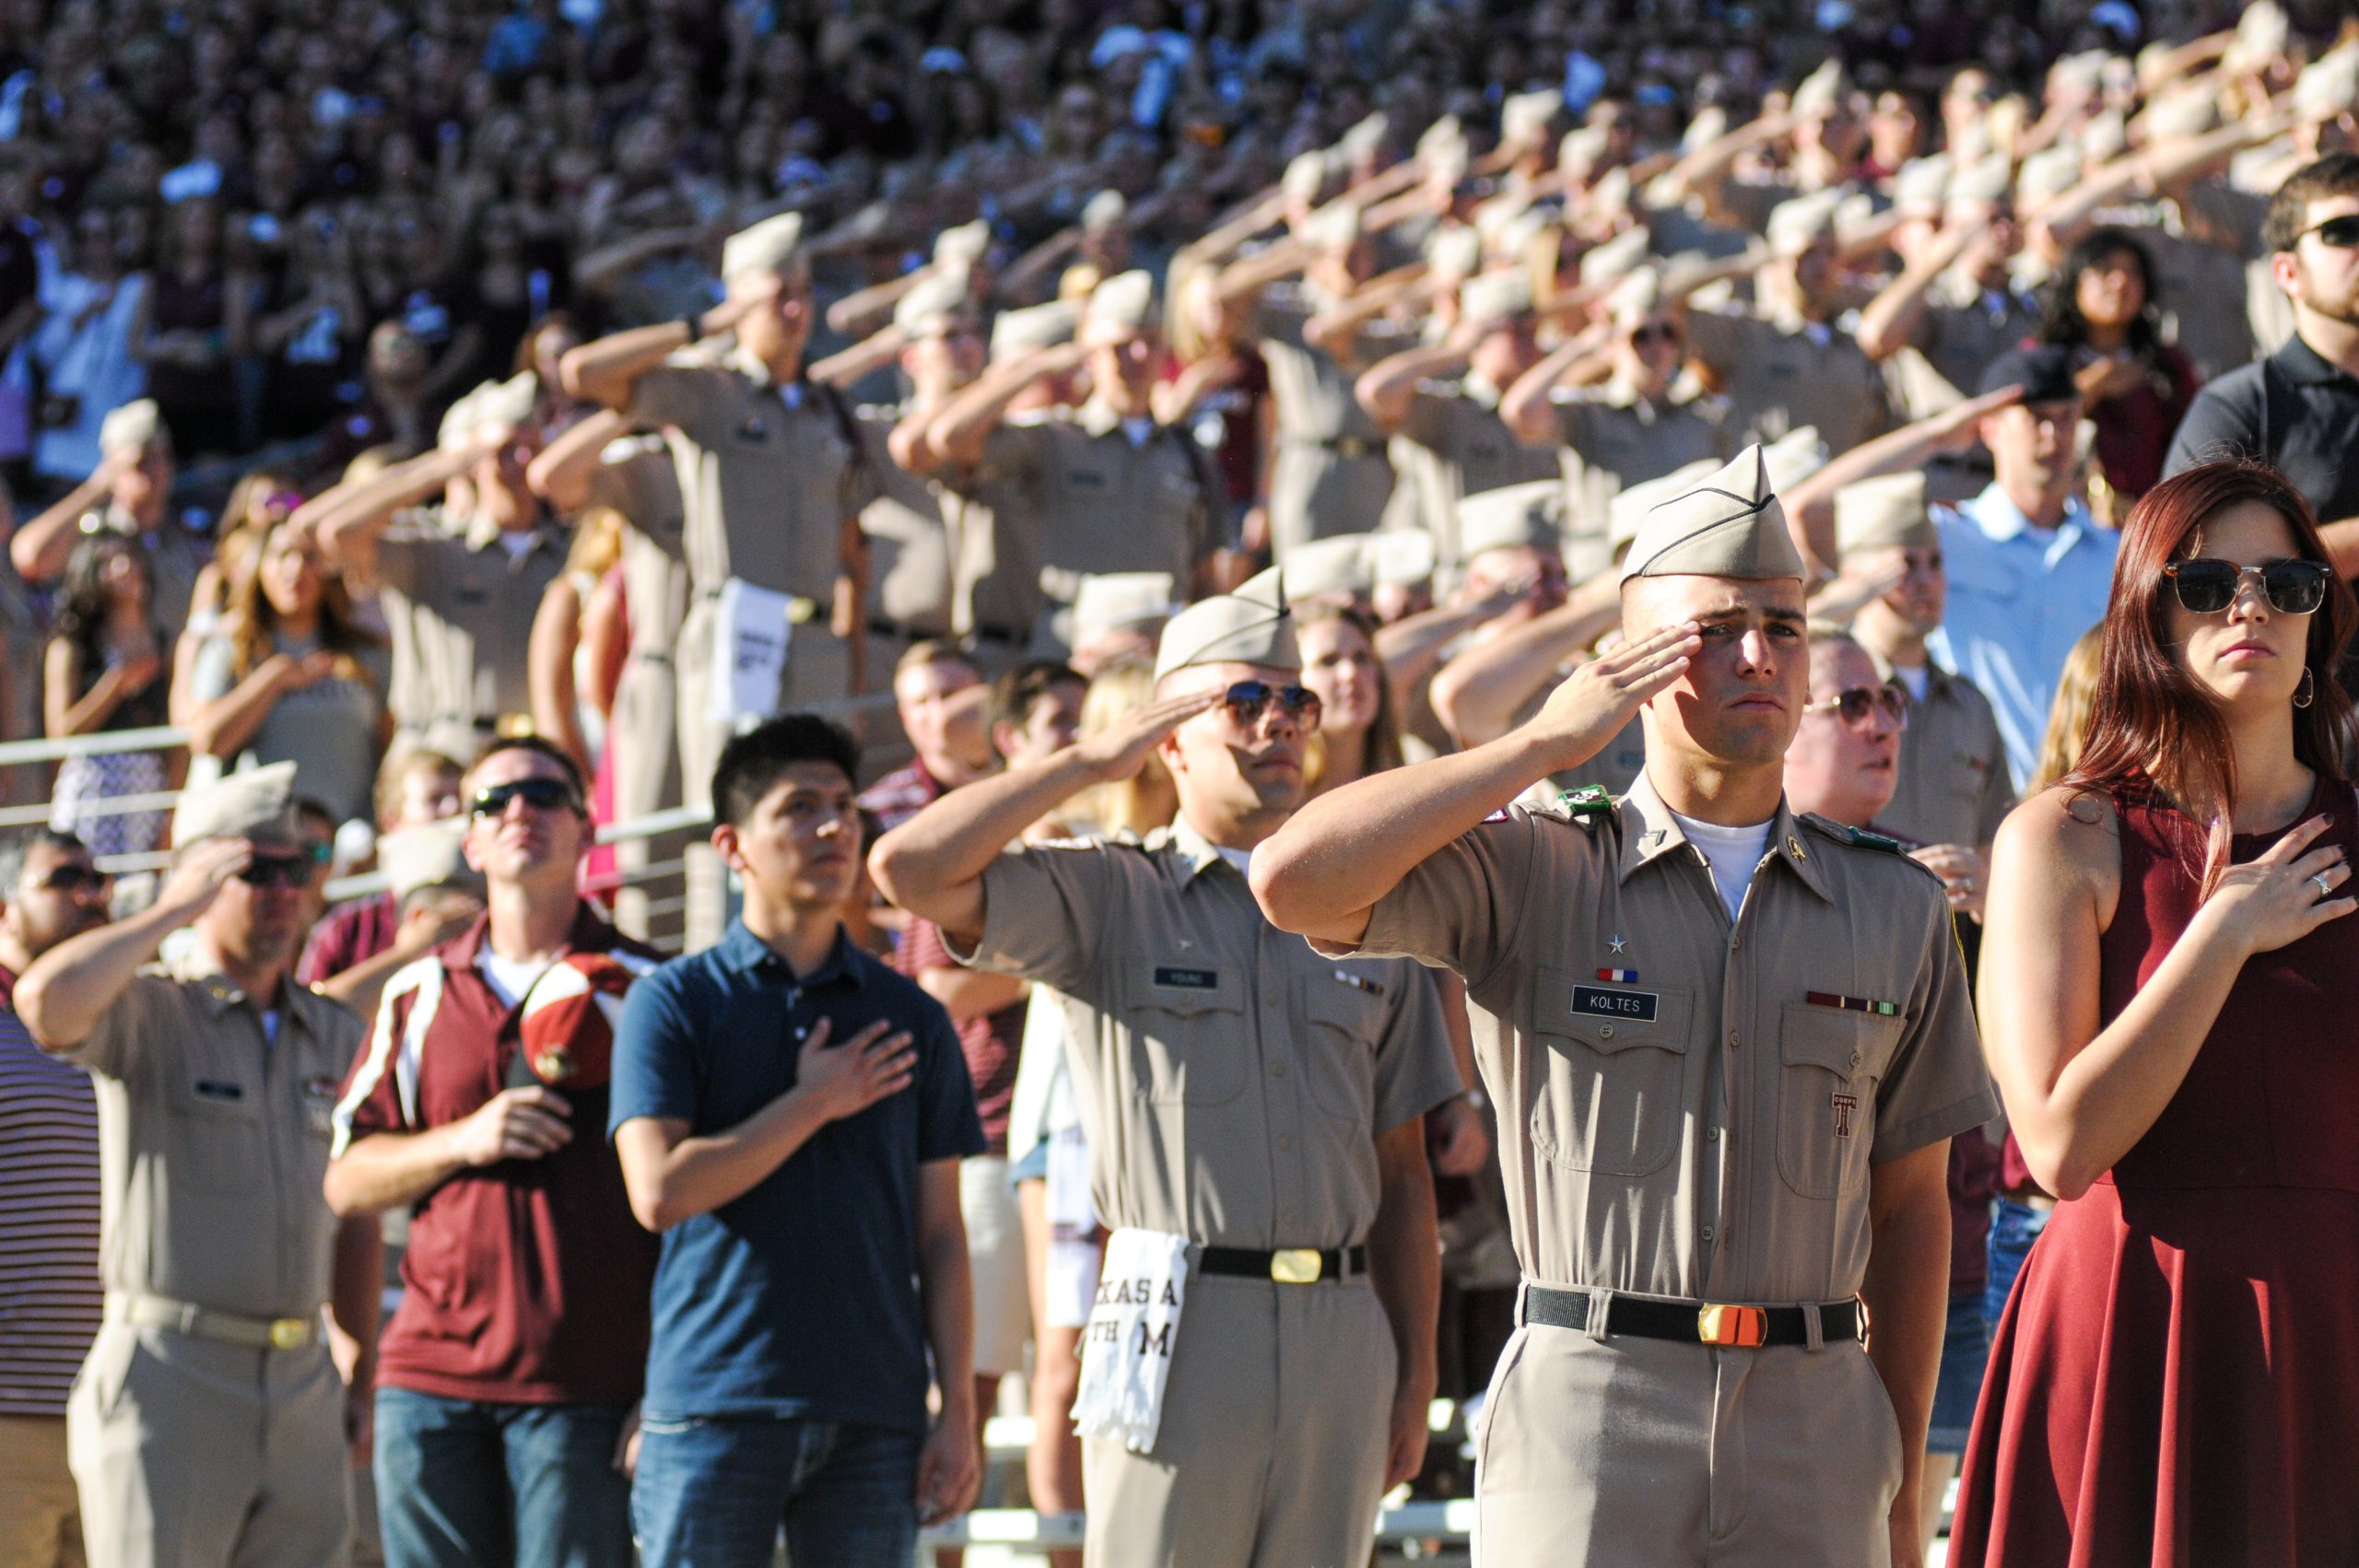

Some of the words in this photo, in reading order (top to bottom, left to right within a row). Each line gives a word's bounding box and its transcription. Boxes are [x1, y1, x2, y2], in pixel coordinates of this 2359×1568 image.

[1590, 995, 1640, 1012] KOLTES
[1834, 1096, 1856, 1106] CORPS
[1159, 1278, 1178, 1306] A
[1139, 1321, 1171, 1356] M
